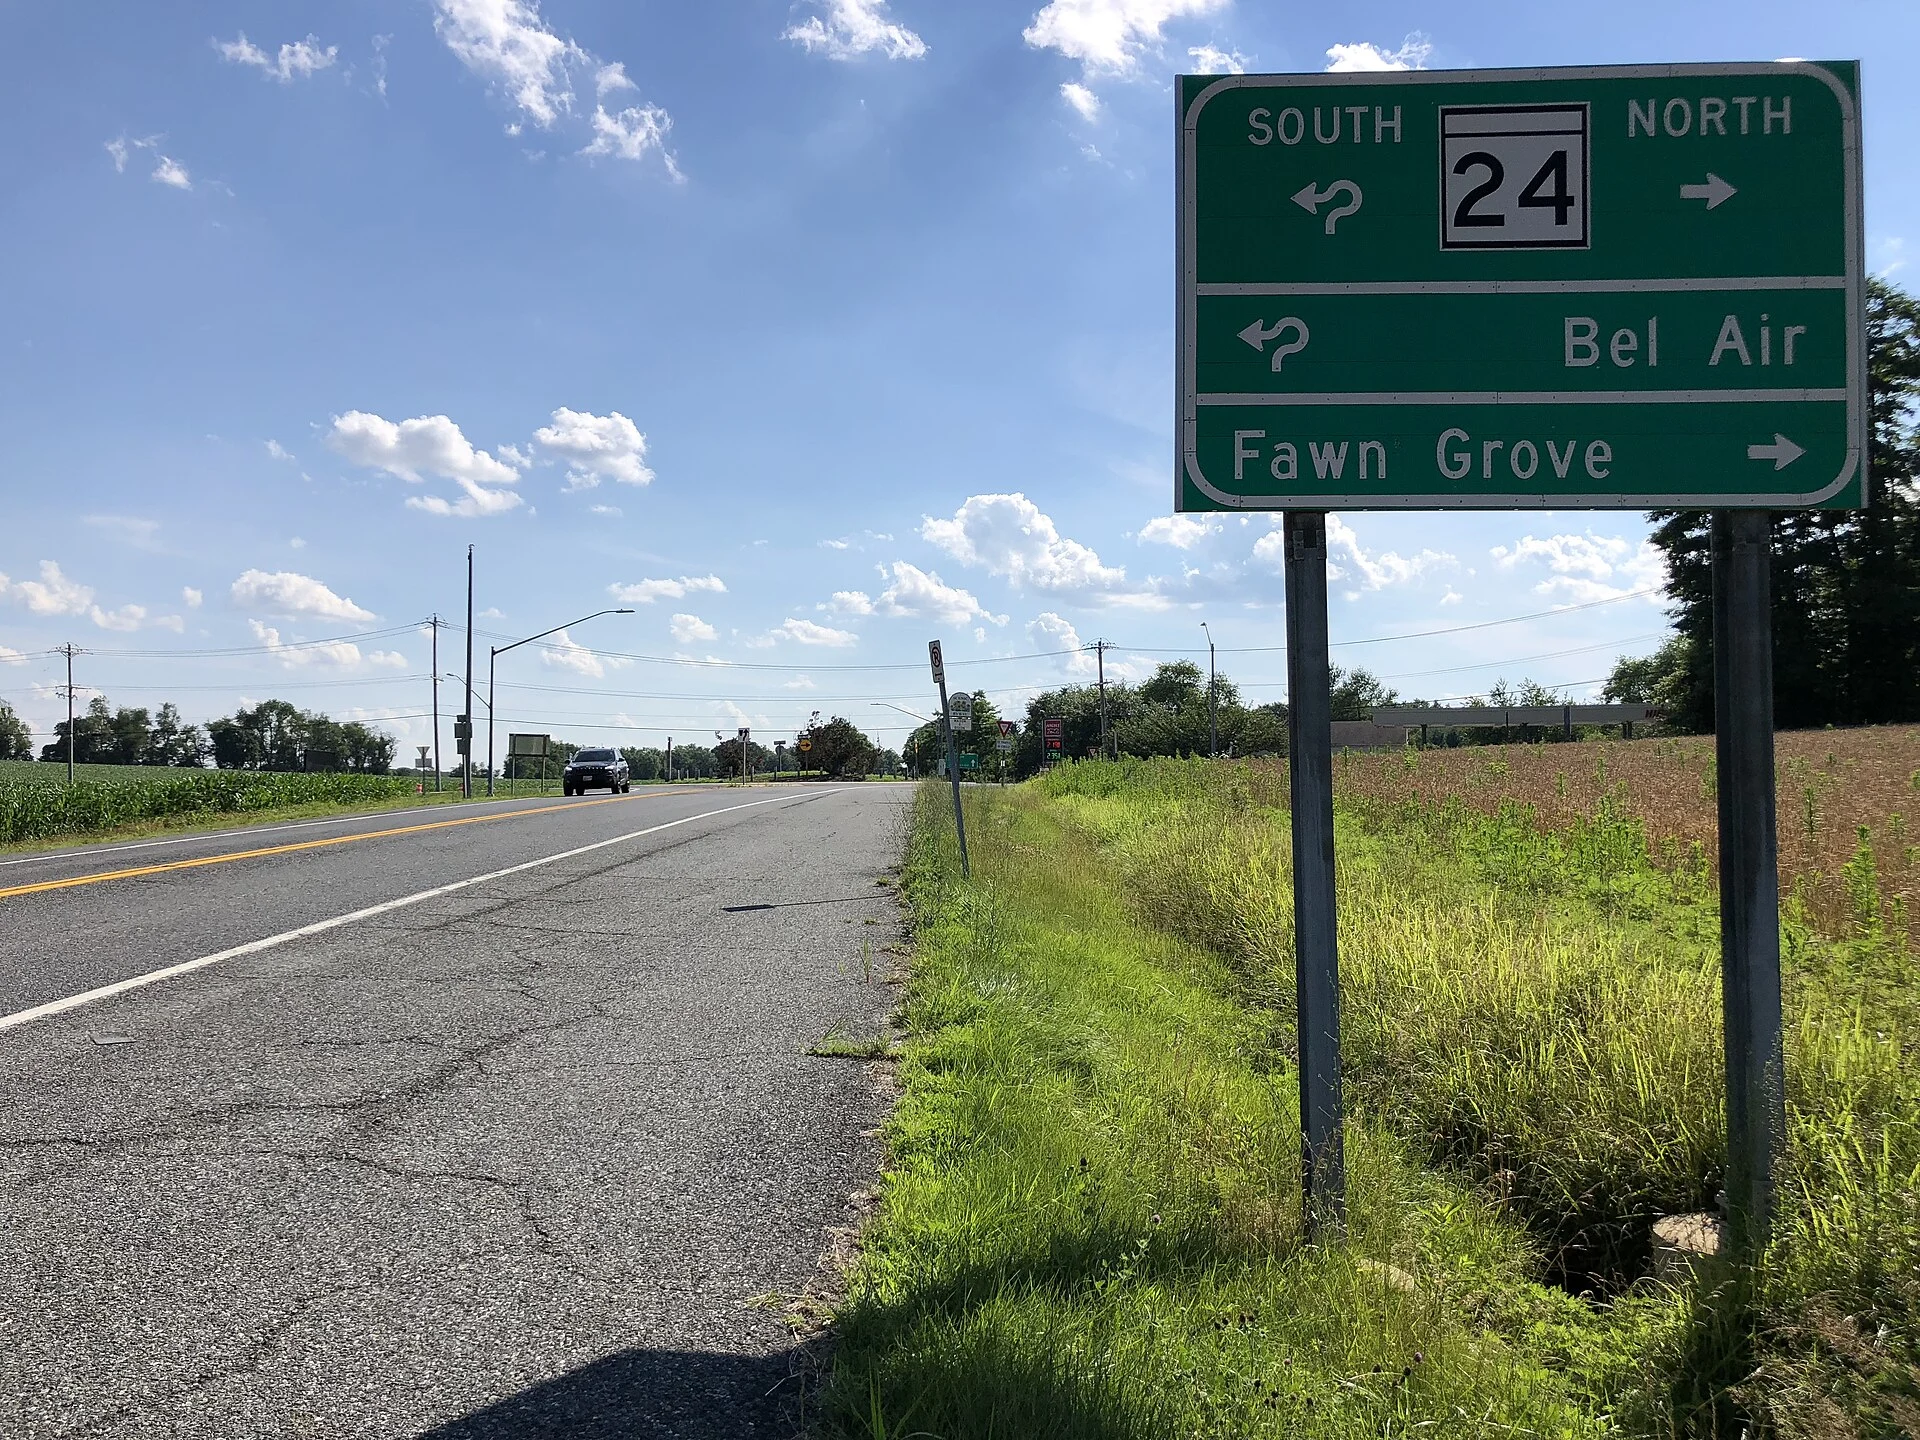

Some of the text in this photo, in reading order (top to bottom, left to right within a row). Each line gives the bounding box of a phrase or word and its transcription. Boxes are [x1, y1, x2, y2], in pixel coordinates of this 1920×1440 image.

[1247, 105, 1402, 146] SOUTH
[1627, 96, 1792, 138] NORTH
[1452, 150, 1575, 228] 24
[1564, 313, 1807, 367] Bel Air
[1234, 427, 1613, 480] Fawn Grove
